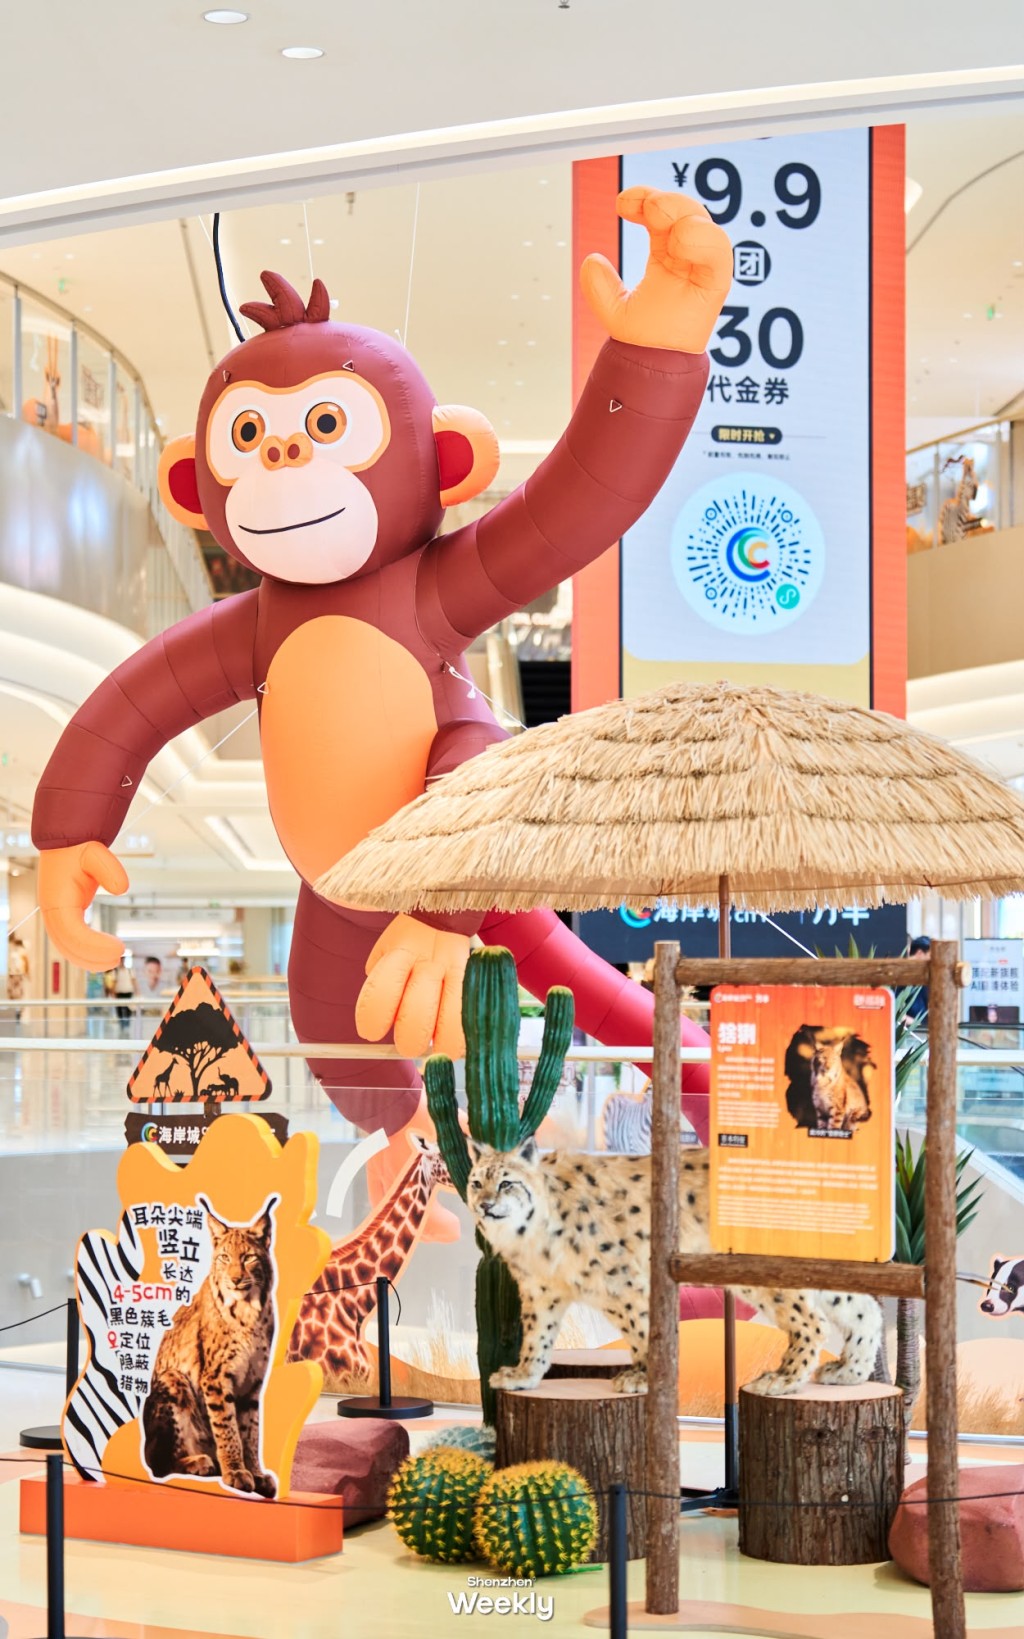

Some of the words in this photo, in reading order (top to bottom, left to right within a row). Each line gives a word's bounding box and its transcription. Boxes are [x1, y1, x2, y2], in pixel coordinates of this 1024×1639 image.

[706, 374, 789, 405] 代金券
[132, 1205, 203, 1230] 耳朵尖端
[159, 1228, 200, 1263] 竖立
[163, 1262, 194, 1283] 长达
[109, 1307, 172, 1328] 黑色簇毛
[119, 1331, 151, 1350] 定位
[119, 1353, 150, 1371] 隐蔽
[119, 1374, 149, 1394] 猎物
